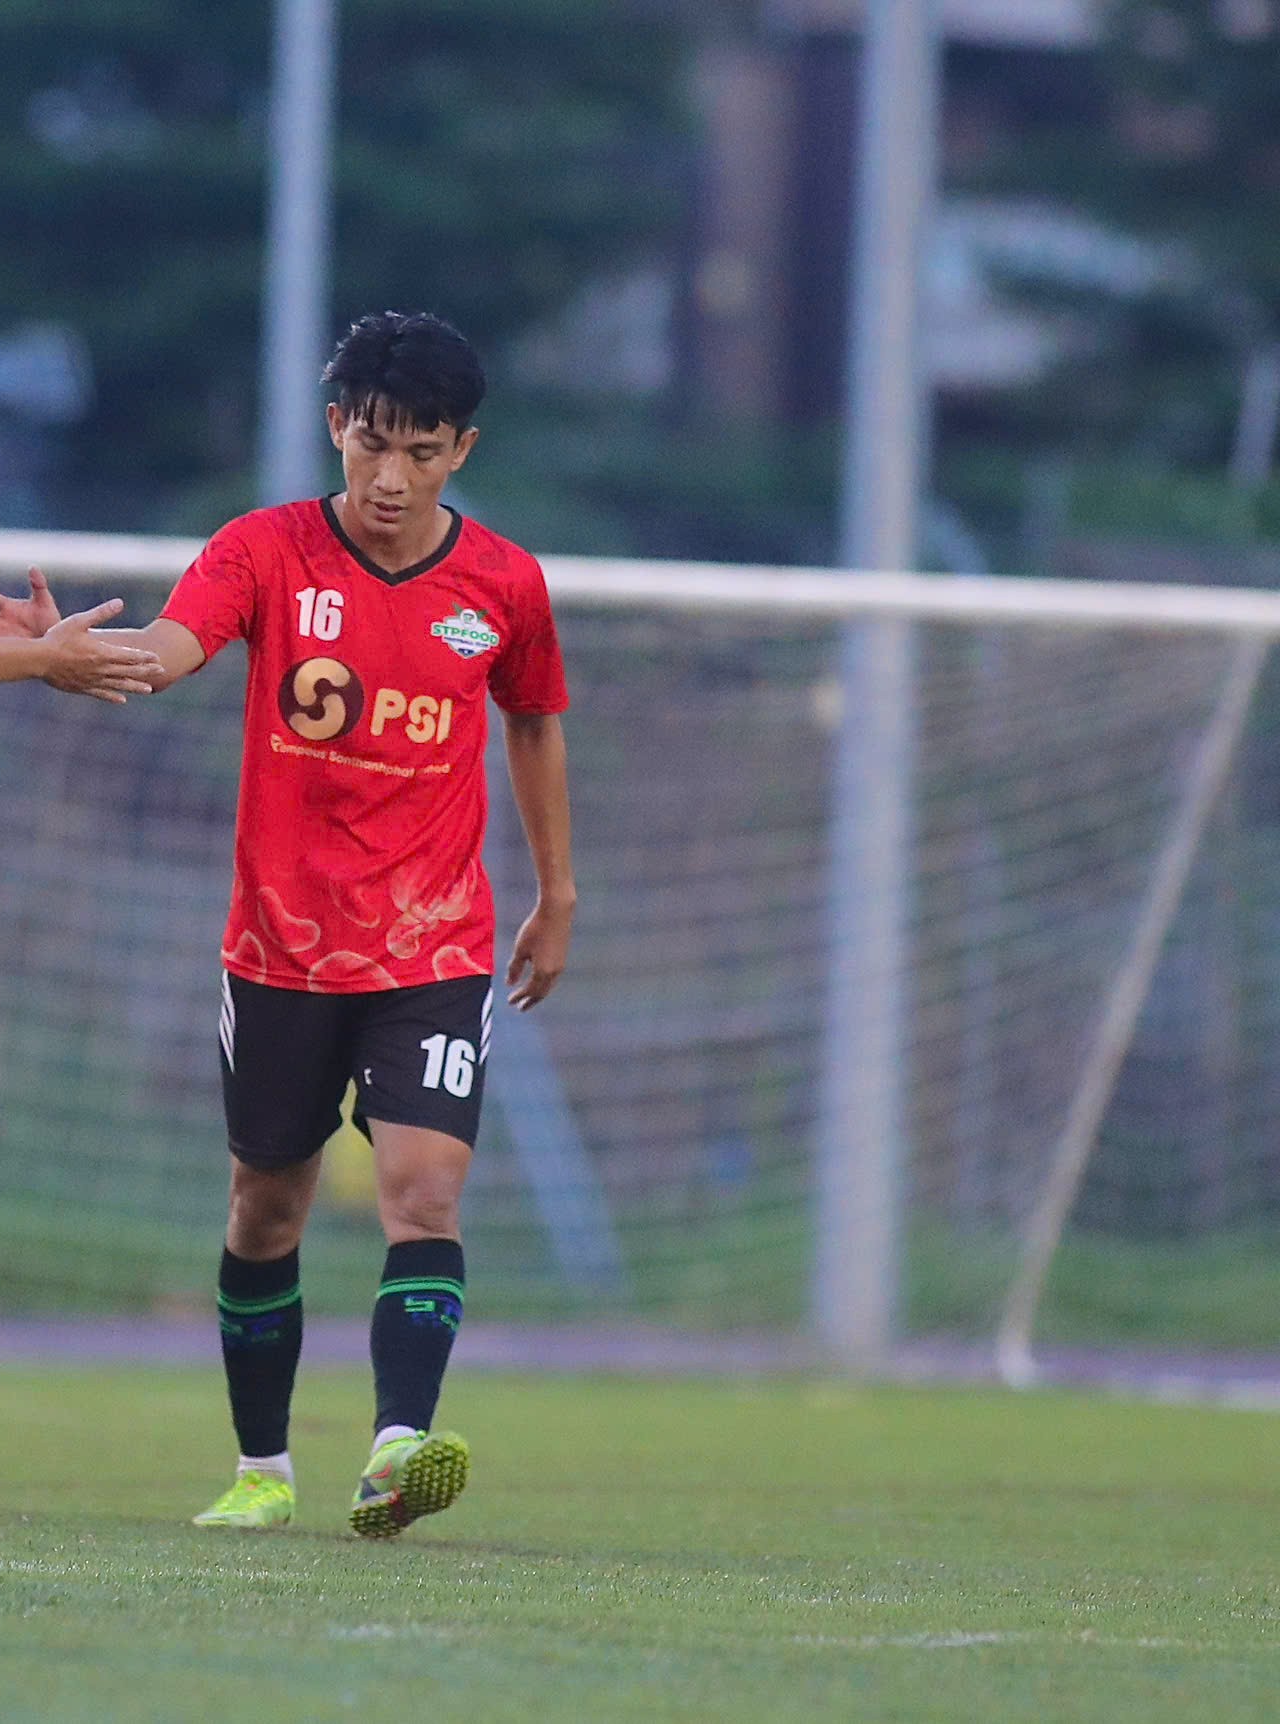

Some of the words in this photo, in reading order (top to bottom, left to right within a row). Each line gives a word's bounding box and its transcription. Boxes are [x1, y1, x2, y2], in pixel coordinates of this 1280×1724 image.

[295, 586, 345, 642] 16
[432, 623, 499, 646] STPFOOD
[420, 1033, 476, 1098] 16
